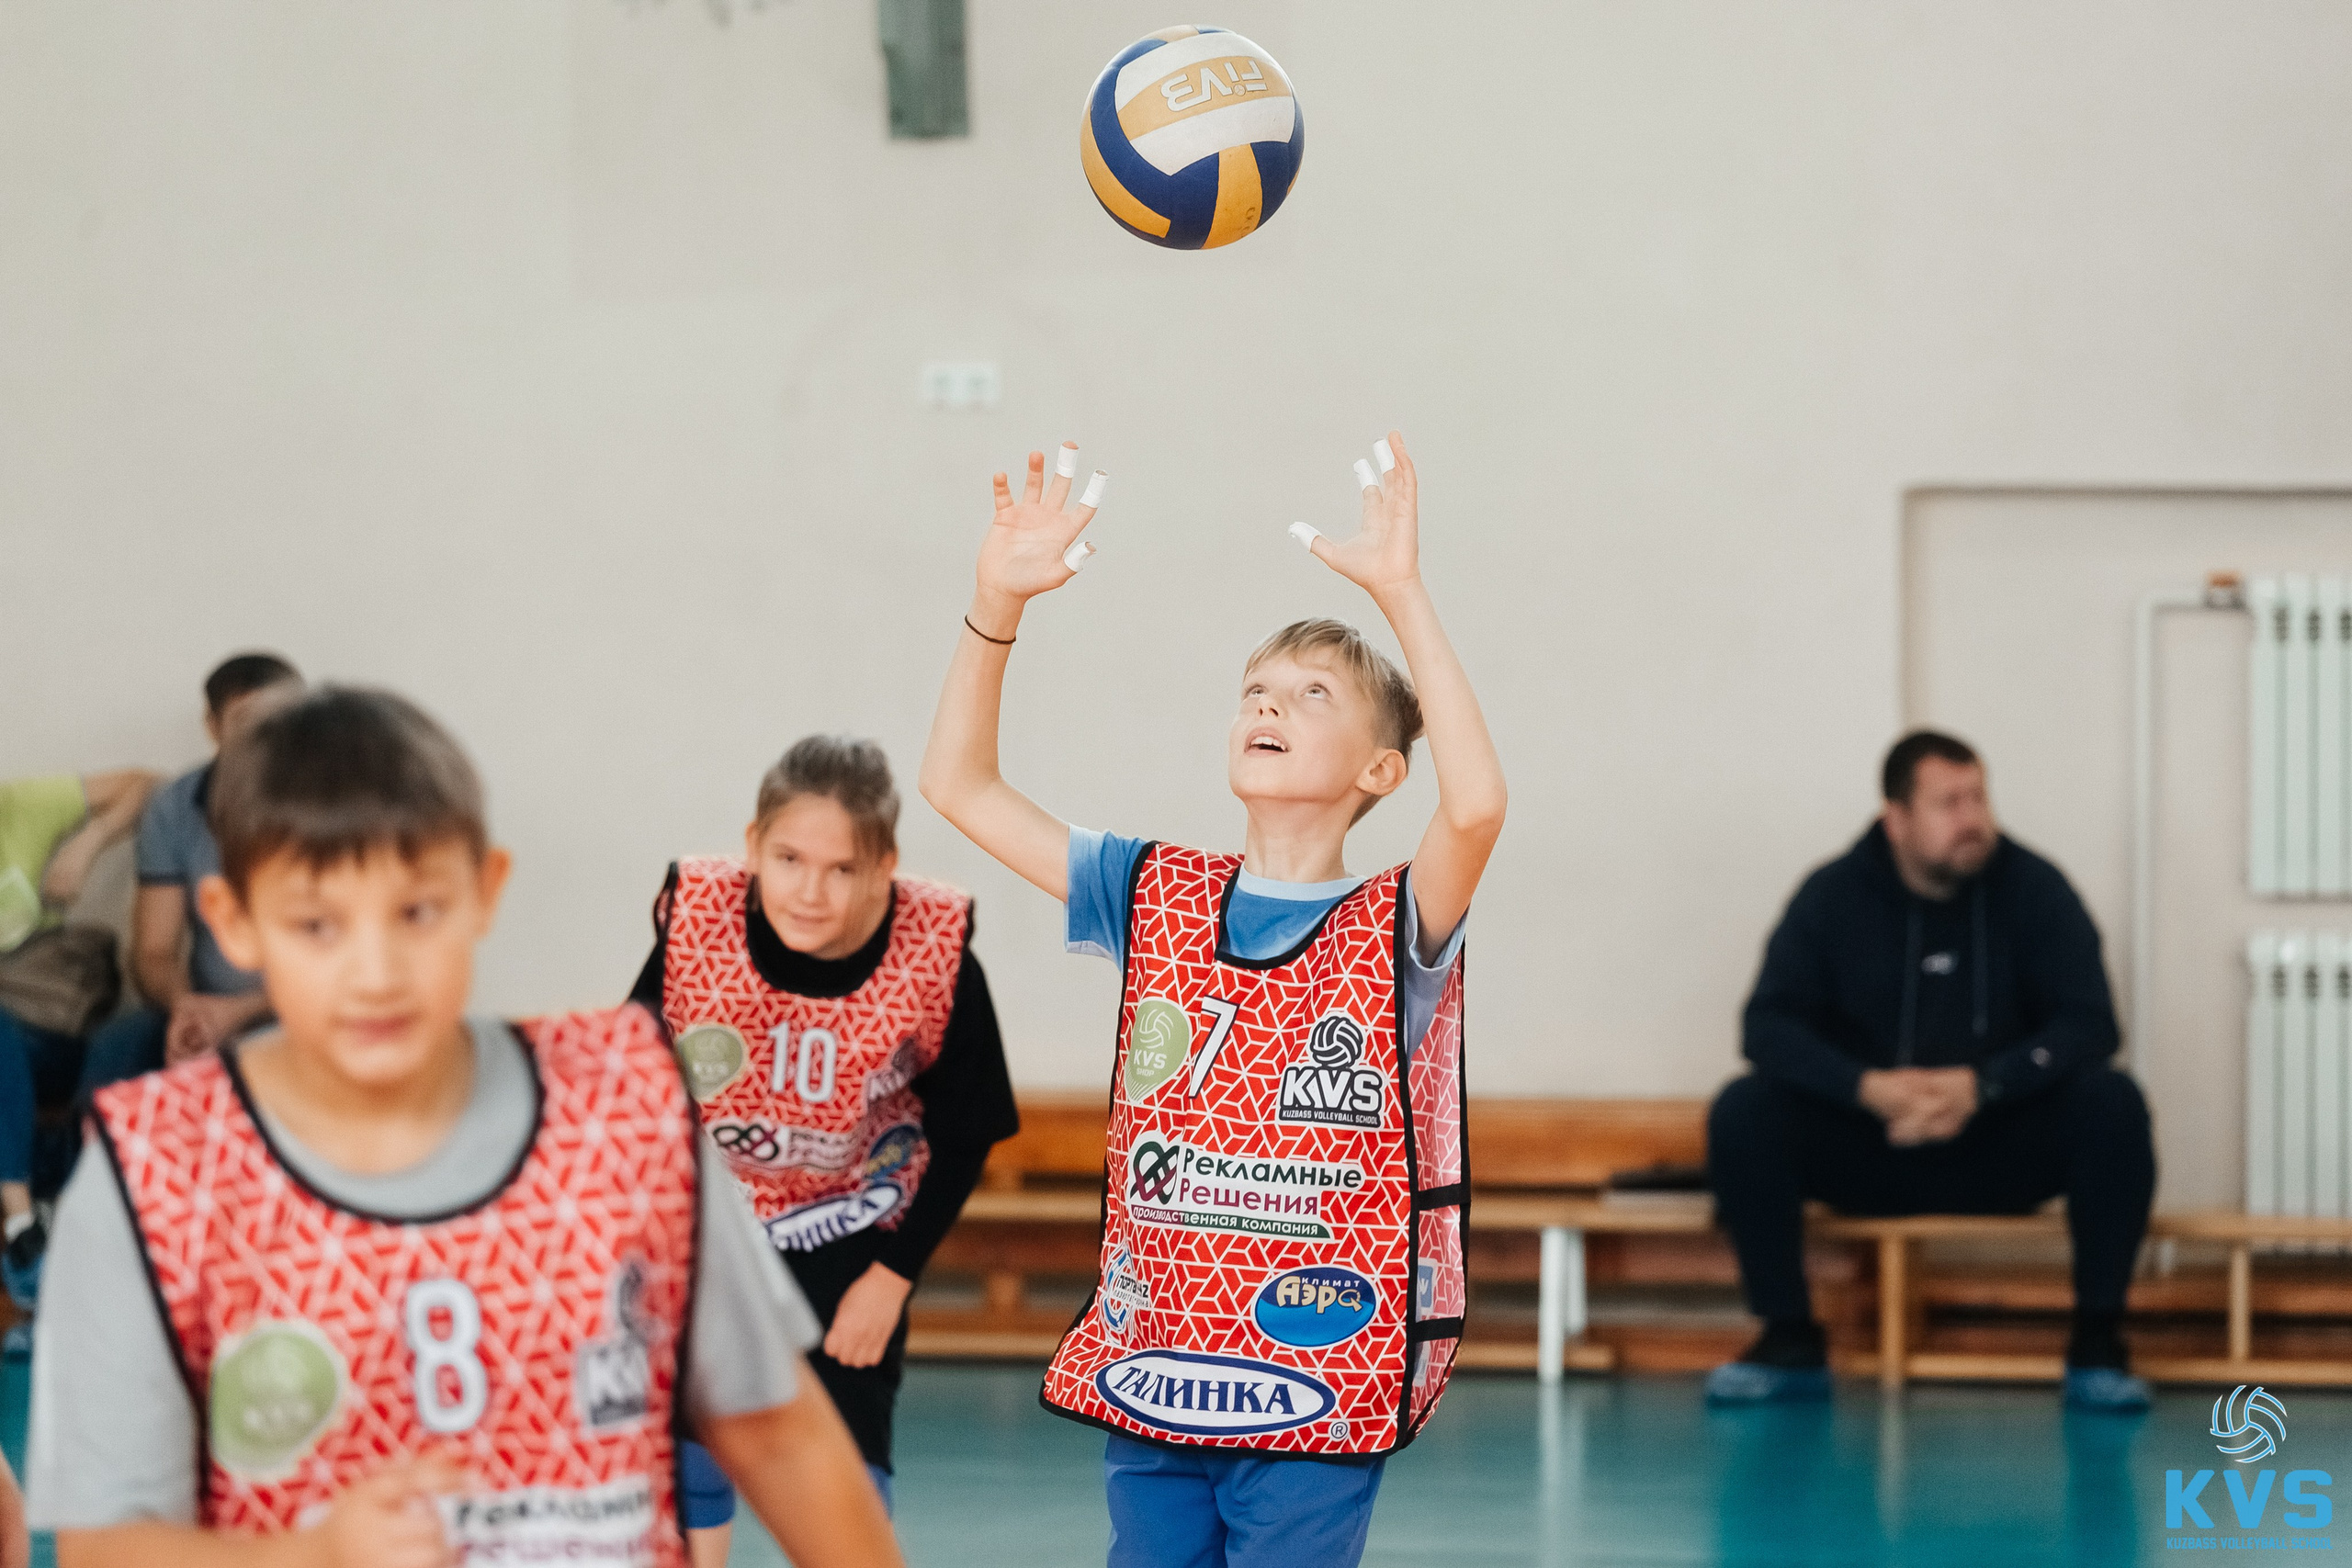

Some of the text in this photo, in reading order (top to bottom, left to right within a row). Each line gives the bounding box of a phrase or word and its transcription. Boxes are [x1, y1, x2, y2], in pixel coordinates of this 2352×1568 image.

[768, 1021, 836, 1102] 10
[1134, 1049, 1168, 1069] KVS
[1189, 995, 1240, 1099] 7
[1136, 1067, 1155, 1077] SHOP
[1283, 1068, 1380, 1112] KVS
[1282, 1110, 1378, 1125] KUZBASS VOLLEYBALL SCHOOL
[1182, 1147, 1363, 1188] Рекламные
[1179, 1178, 1318, 1215] Решения
[1241, 1217, 1319, 1235] компания
[406, 1279, 488, 1432] 8
[1113, 1366, 1297, 1415] ТАЛИНКА
